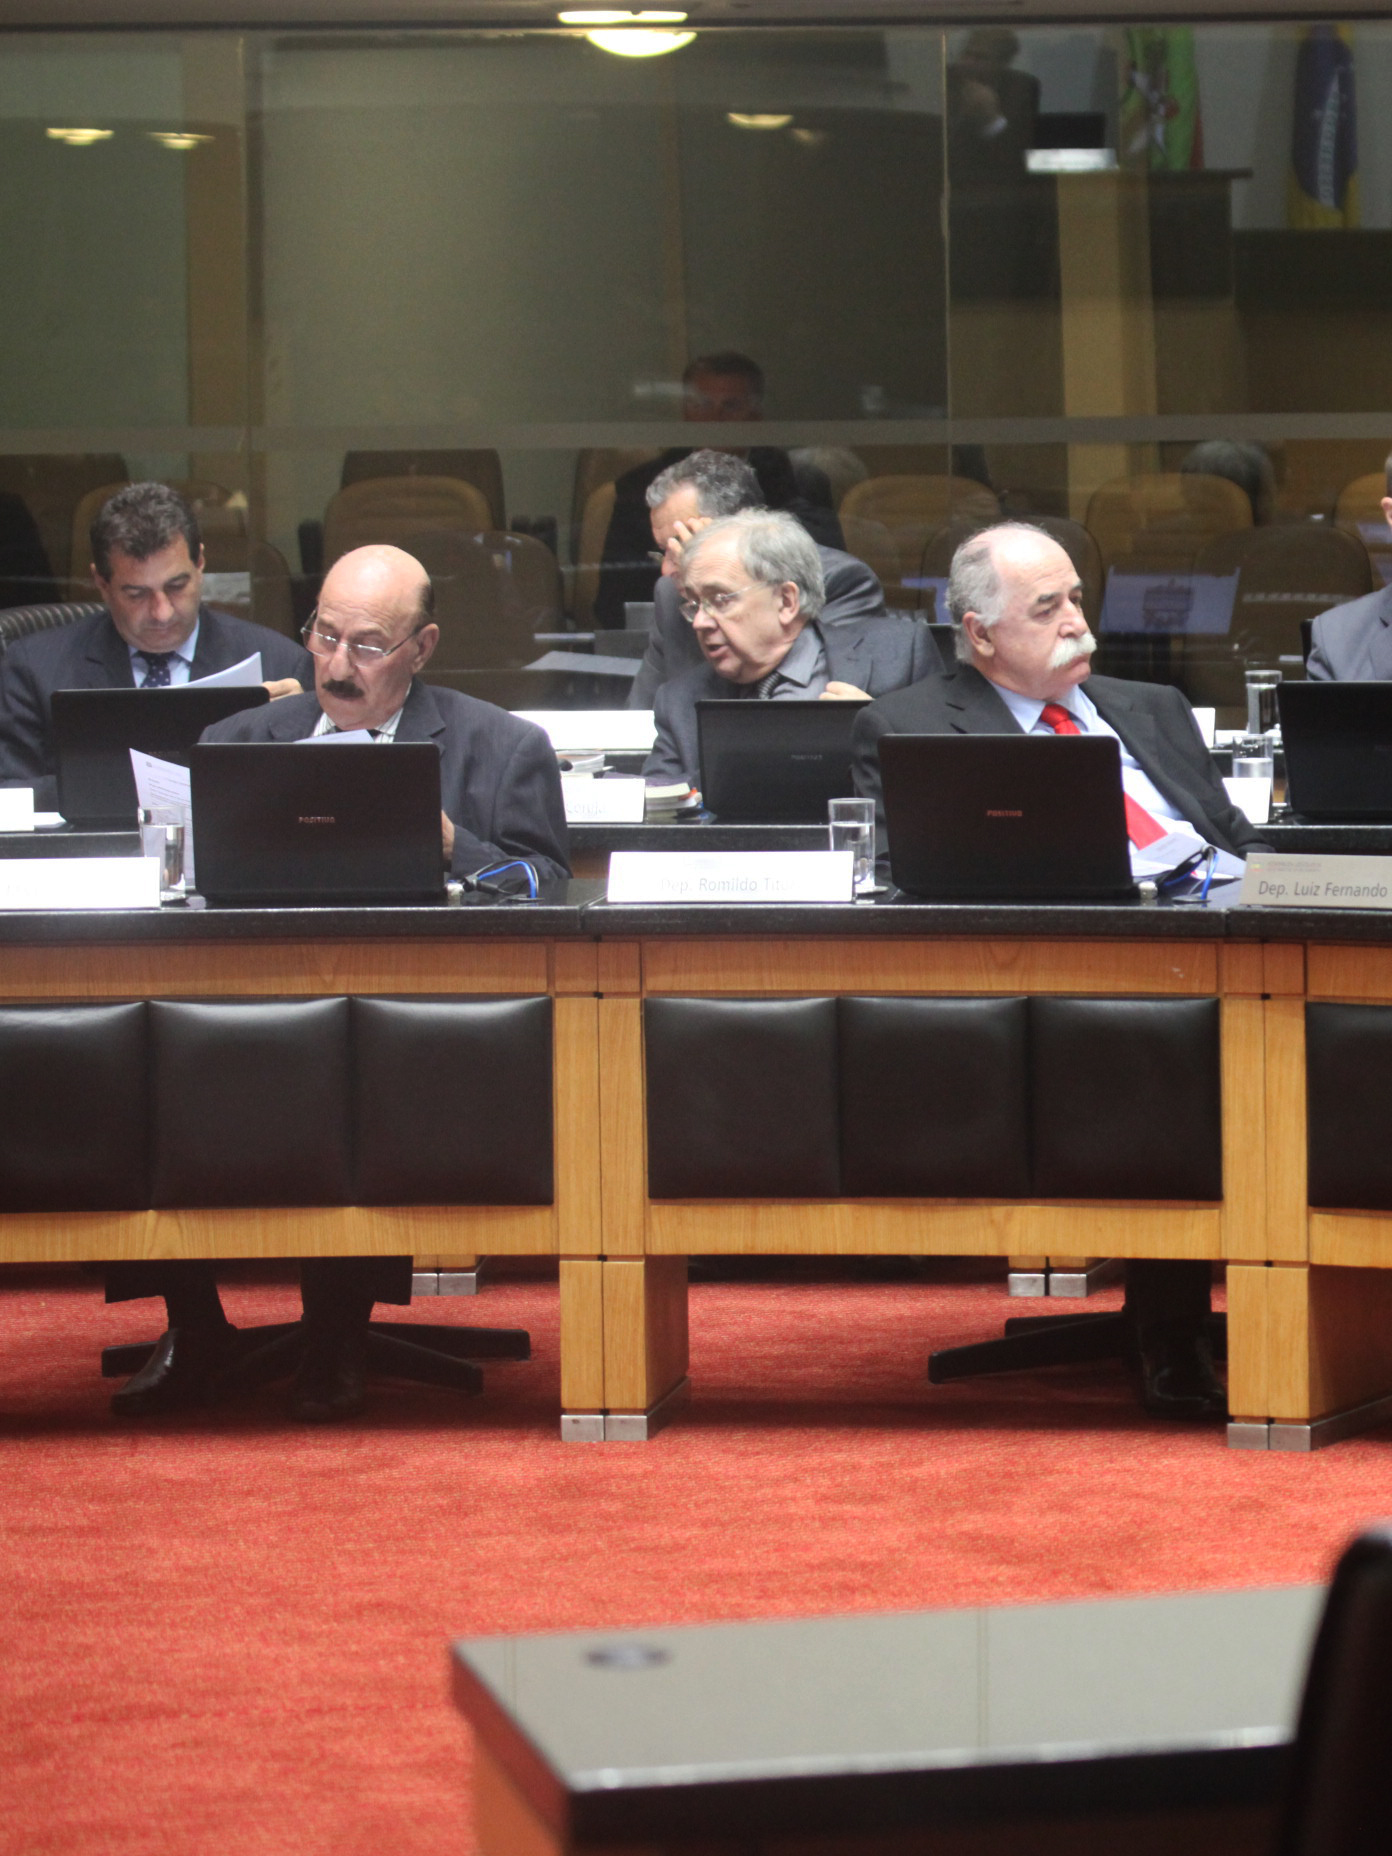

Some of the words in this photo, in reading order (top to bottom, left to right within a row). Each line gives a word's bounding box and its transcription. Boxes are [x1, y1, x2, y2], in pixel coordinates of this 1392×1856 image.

[698, 877, 758, 892] Romildo
[1258, 880, 1289, 899] Dep.
[1293, 881, 1320, 897] Luiz
[1324, 882, 1388, 898] Fernando
